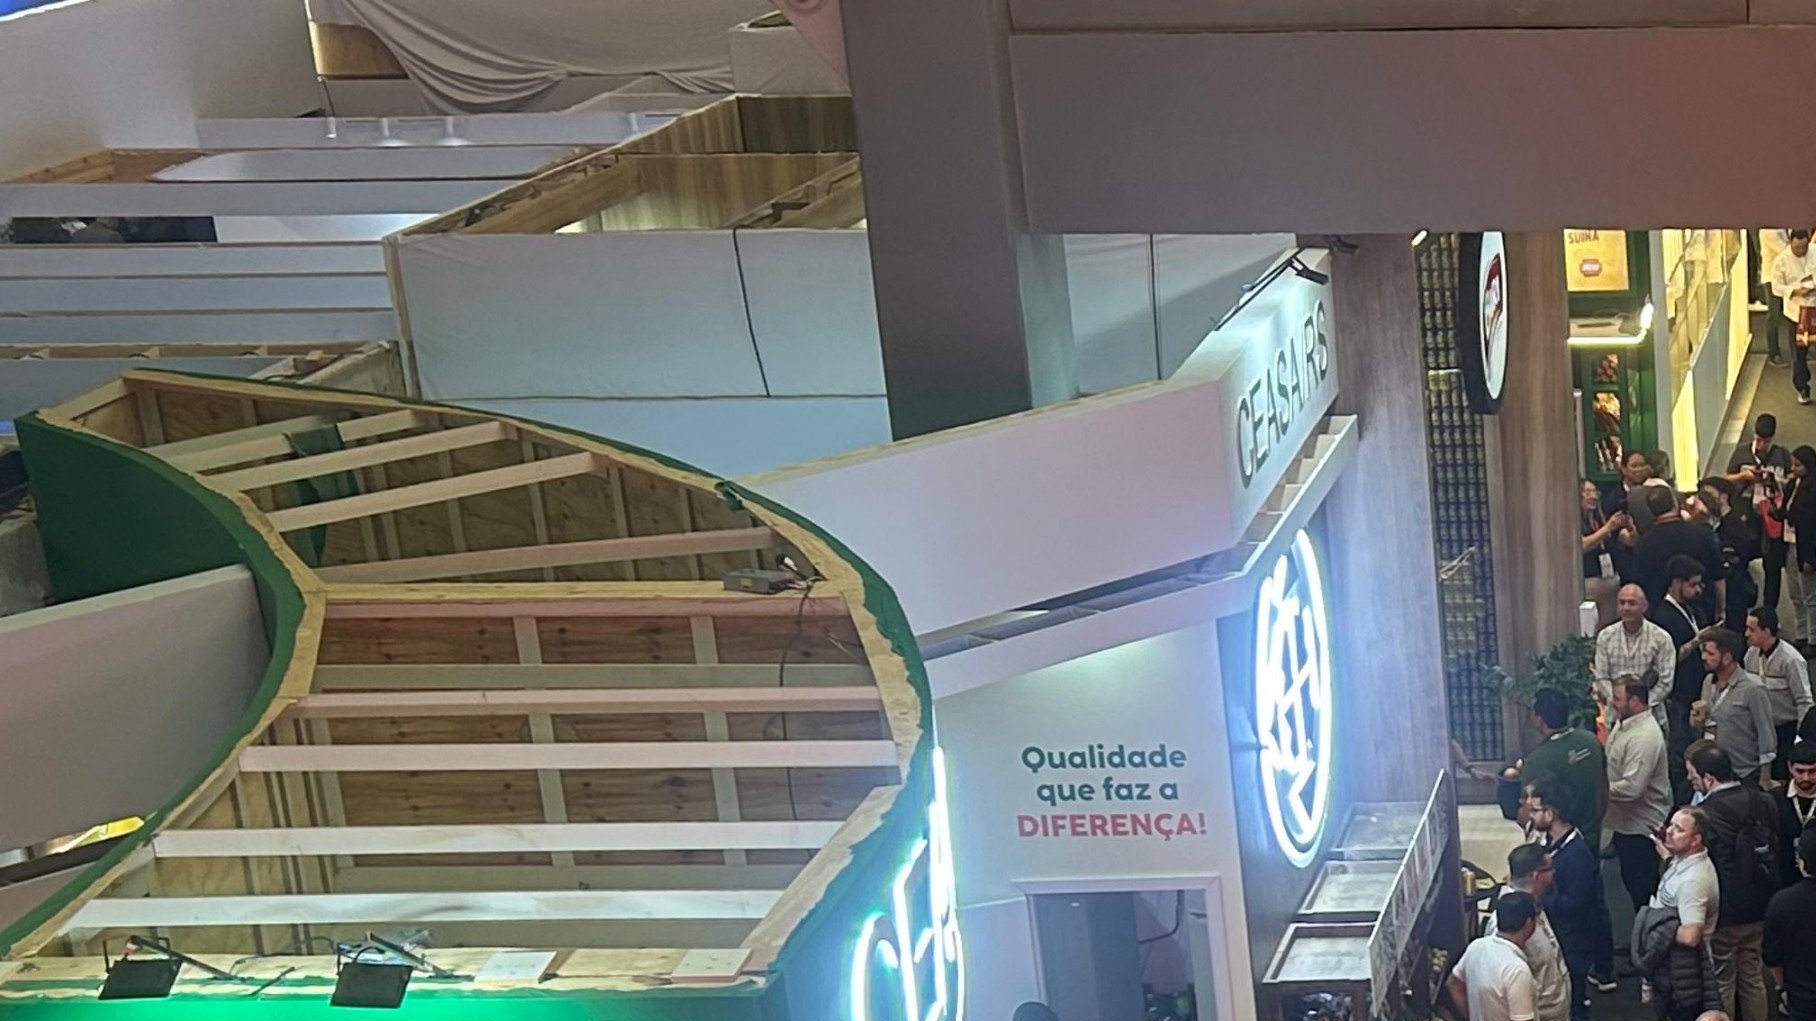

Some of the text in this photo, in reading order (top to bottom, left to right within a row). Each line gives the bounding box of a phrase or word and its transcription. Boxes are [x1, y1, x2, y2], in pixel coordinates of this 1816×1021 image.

[1237, 304, 1329, 488] CEASA/RS
[1021, 743, 1187, 772] Qualidade
[1036, 777, 1178, 808] que faz a
[1017, 811, 1207, 842] DIFERENÇA!
